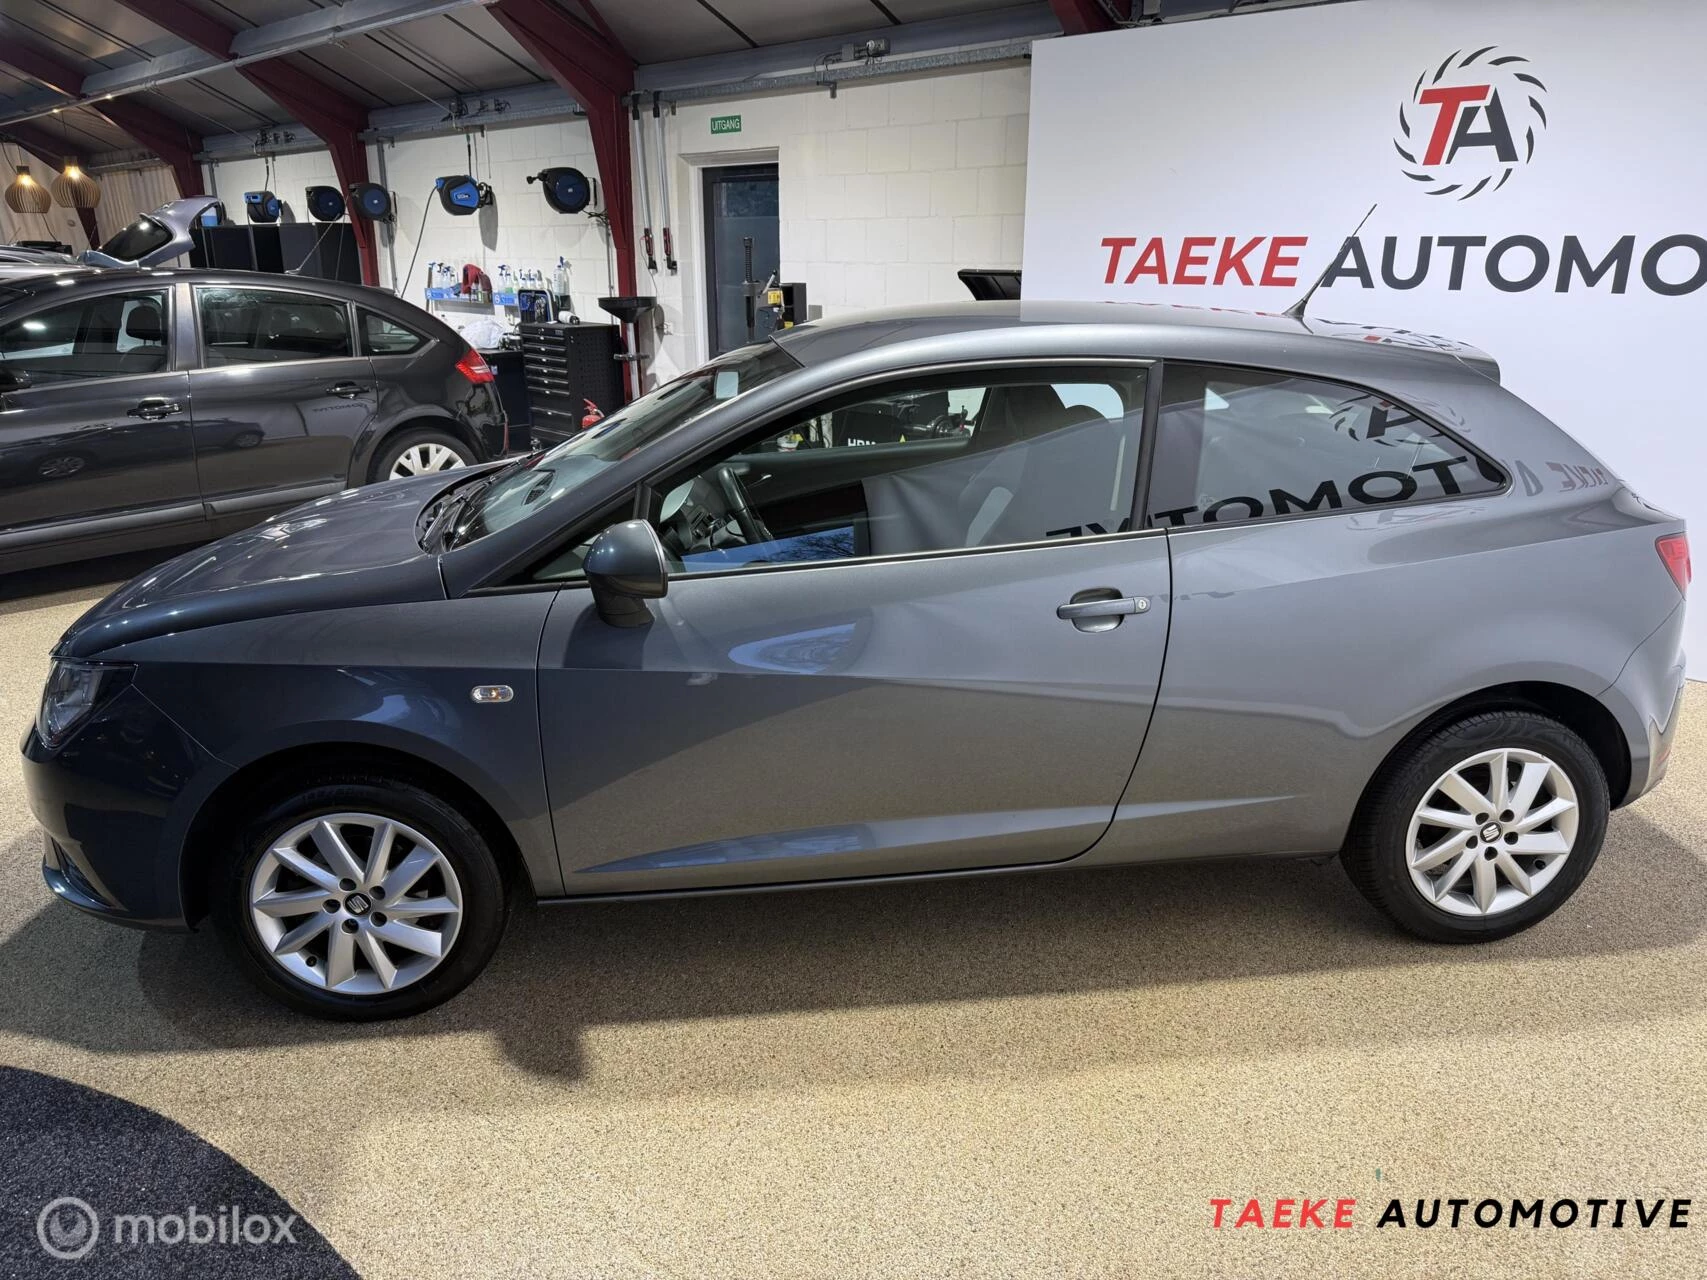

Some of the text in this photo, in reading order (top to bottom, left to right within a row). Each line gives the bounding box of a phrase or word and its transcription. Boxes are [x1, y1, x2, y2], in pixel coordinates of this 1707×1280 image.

[711, 118, 740, 131] UITGANG
[1417, 84, 1518, 167] TA
[1101, 236, 1308, 287] TAEKE
